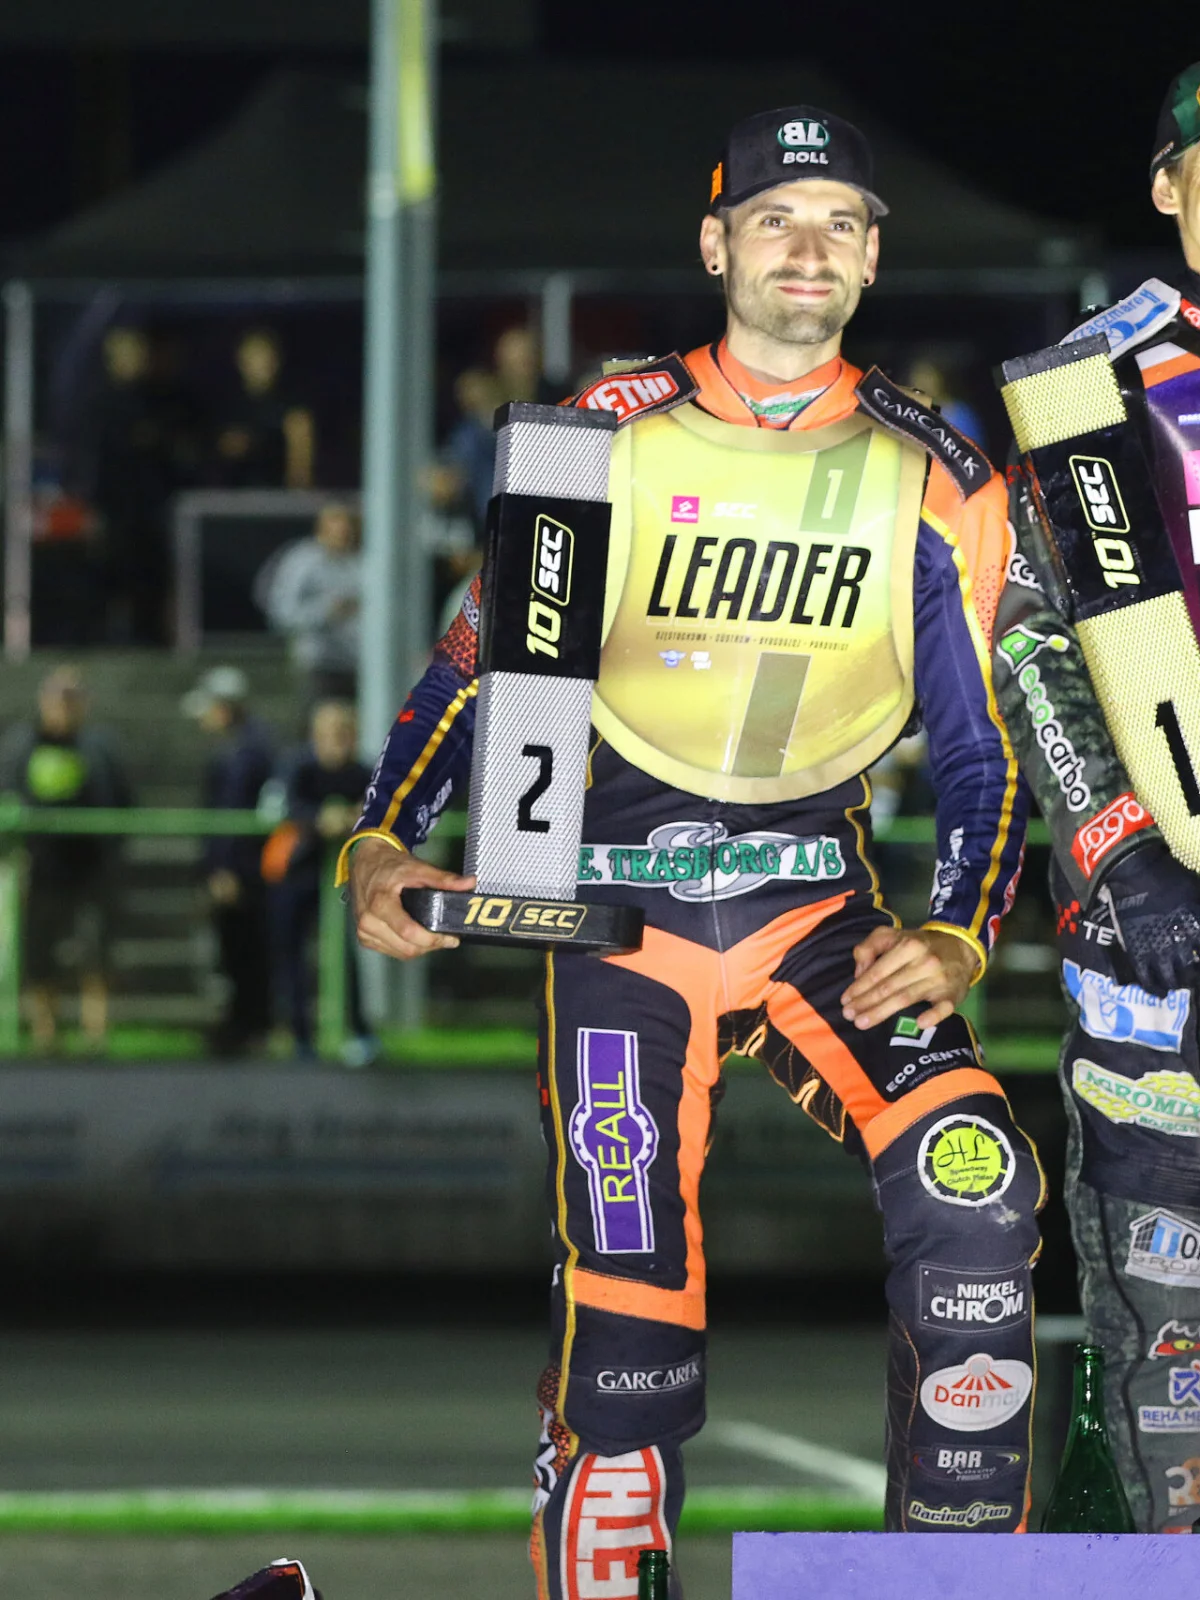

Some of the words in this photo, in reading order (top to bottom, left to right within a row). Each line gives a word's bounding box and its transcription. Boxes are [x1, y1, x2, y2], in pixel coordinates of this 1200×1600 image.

[782, 151, 829, 164] BOLL
[1078, 462, 1117, 525] SEC
[538, 526, 564, 594] SEC
[1094, 538, 1141, 589] 10
[646, 534, 872, 629] LEADER
[526, 600, 562, 659] 10
[1020, 667, 1088, 808] ecocarbo
[517, 743, 554, 833] 2
[607, 841, 782, 882] TRASBORG
[791, 841, 842, 877] A/S
[463, 897, 513, 927] 10
[519, 908, 577, 929] SEC
[886, 1063, 917, 1093] ECO
[591, 1071, 637, 1203] REALL
[946, 1175, 973, 1186] Clutch
[930, 1291, 1024, 1324] CHROM
[957, 1279, 1017, 1299] NIKKEL
[1143, 1409, 1181, 1422] REHA
[937, 1449, 982, 1469] BAR
[911, 1501, 1010, 1525] Racing4Fun
